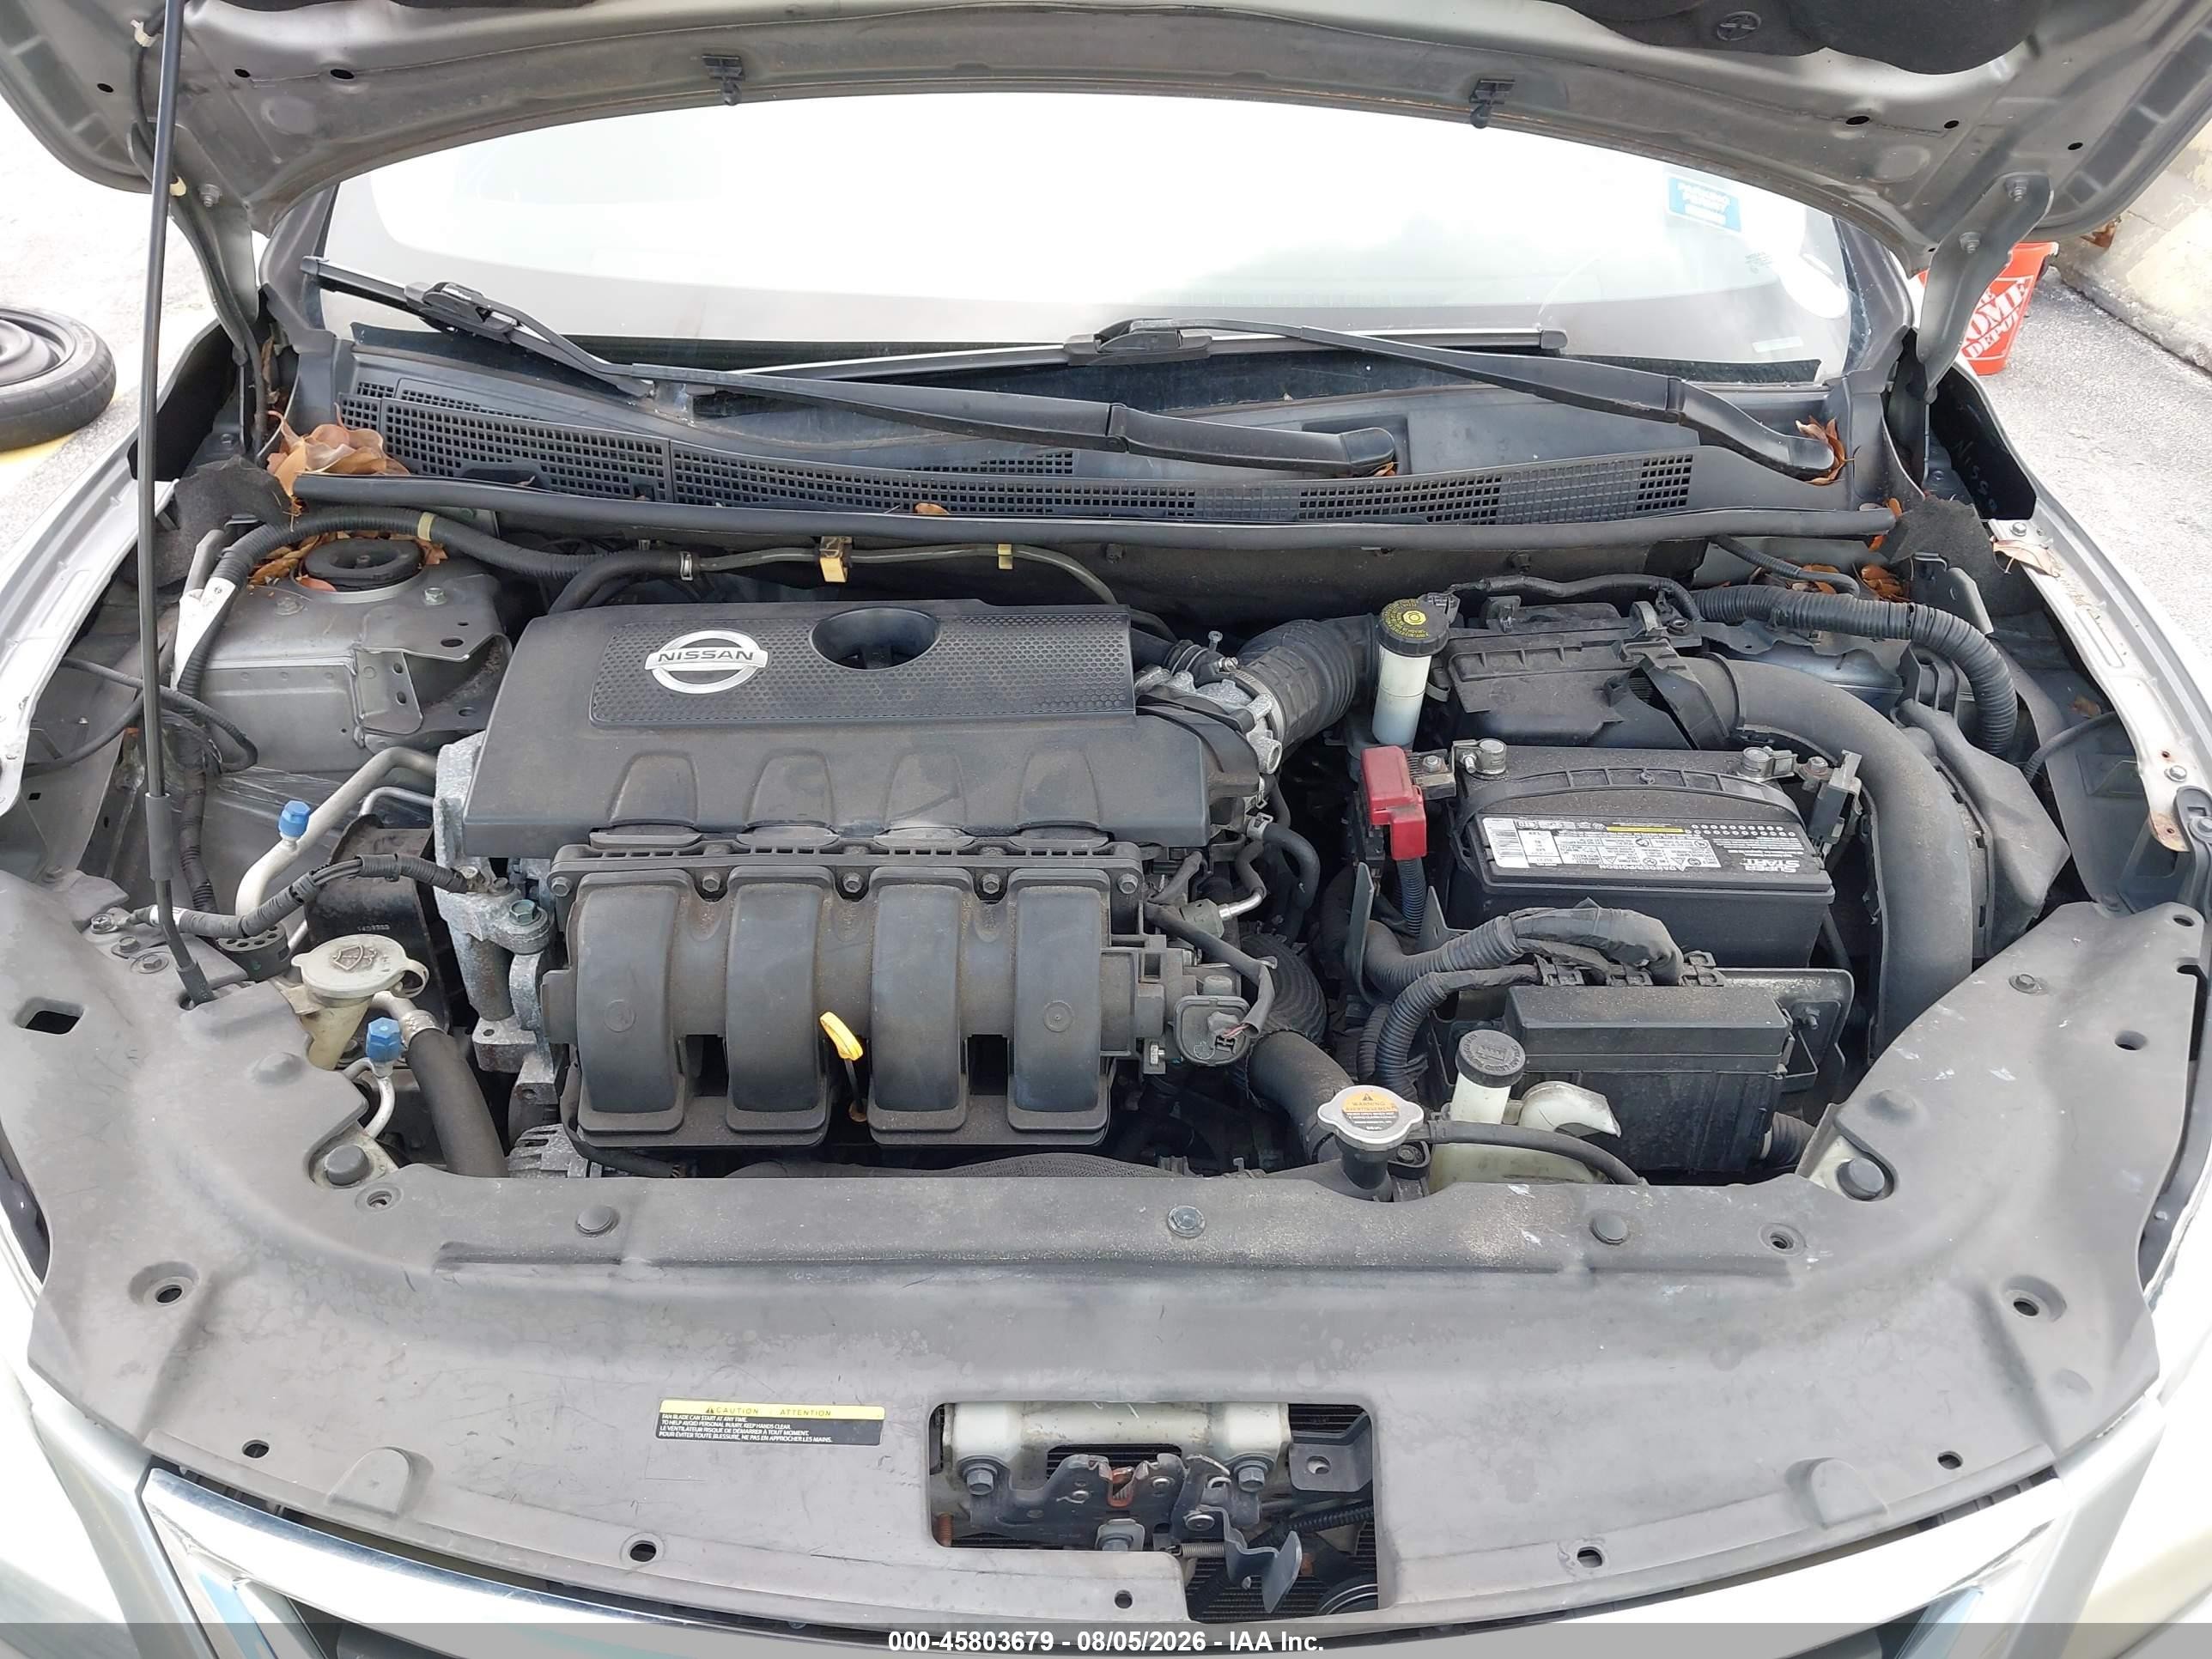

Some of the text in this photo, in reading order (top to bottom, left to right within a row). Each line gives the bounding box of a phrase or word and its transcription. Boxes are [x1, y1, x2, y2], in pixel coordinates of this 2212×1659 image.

[1966, 279, 2026, 341] OME
[658, 650, 755, 662] NISSAN
[1743, 858, 1801, 869] START
[780, 1408, 831, 1417] ATTENTION
